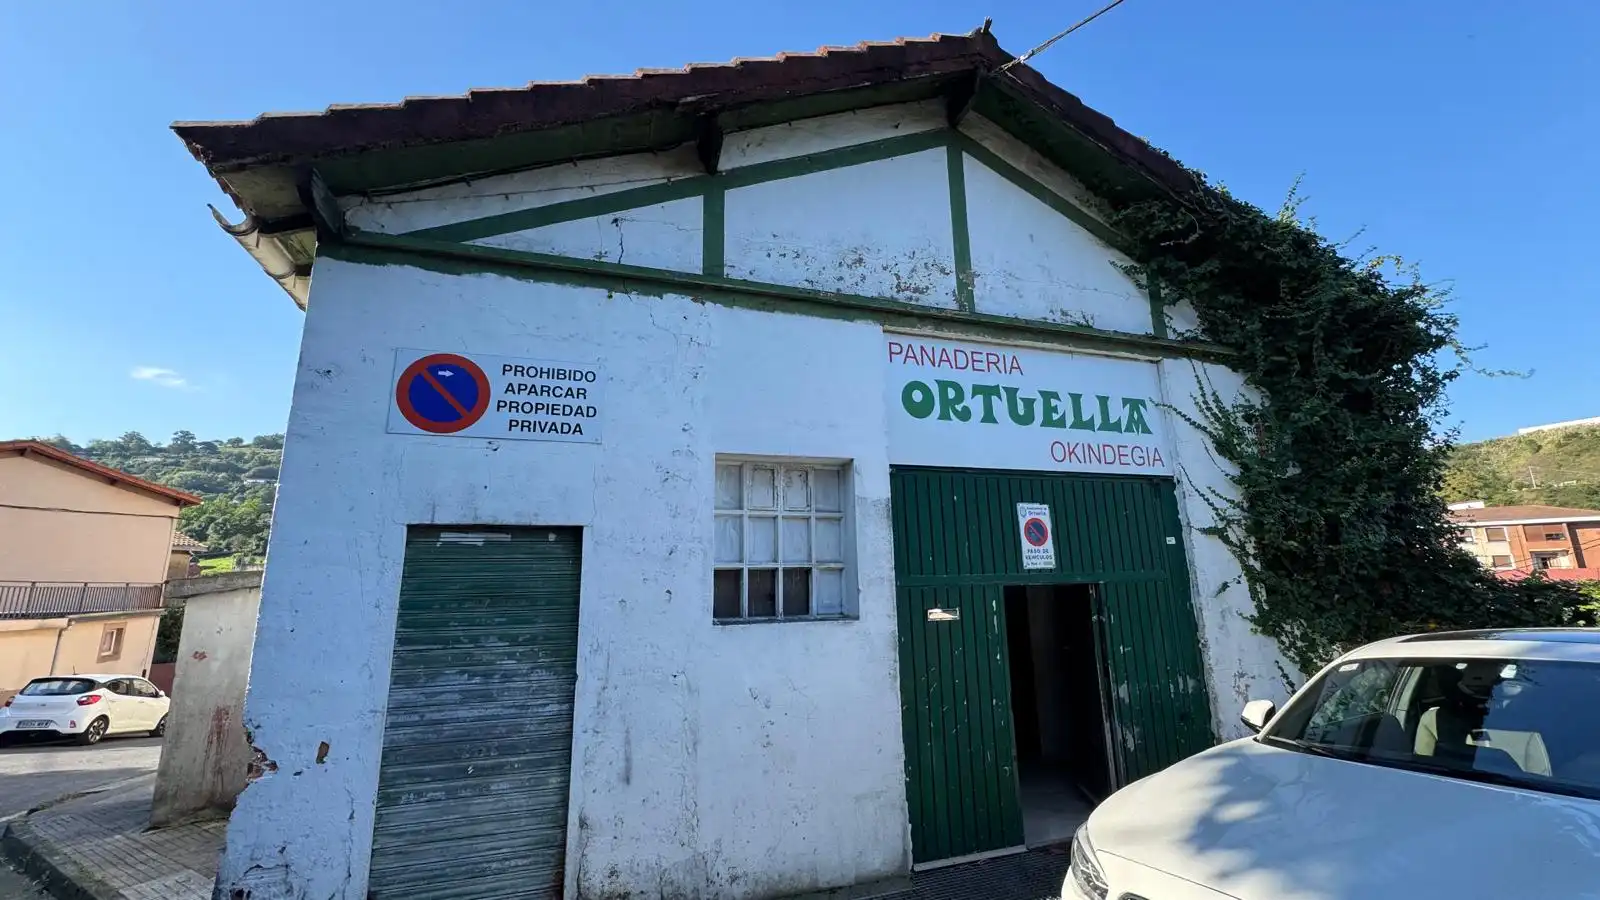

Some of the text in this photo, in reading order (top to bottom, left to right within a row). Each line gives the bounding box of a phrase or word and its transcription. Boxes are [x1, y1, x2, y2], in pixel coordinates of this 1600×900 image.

[888, 341, 1024, 376] PANADERIA
[502, 364, 597, 383] PROHIBIDO
[504, 382, 587, 400] APARCAR
[496, 400, 597, 418] PROPIEDAD
[901, 379, 1153, 435] ORTUELLA
[508, 419, 584, 436] PRIVADA
[1050, 440, 1165, 468] OKINDEGIA
